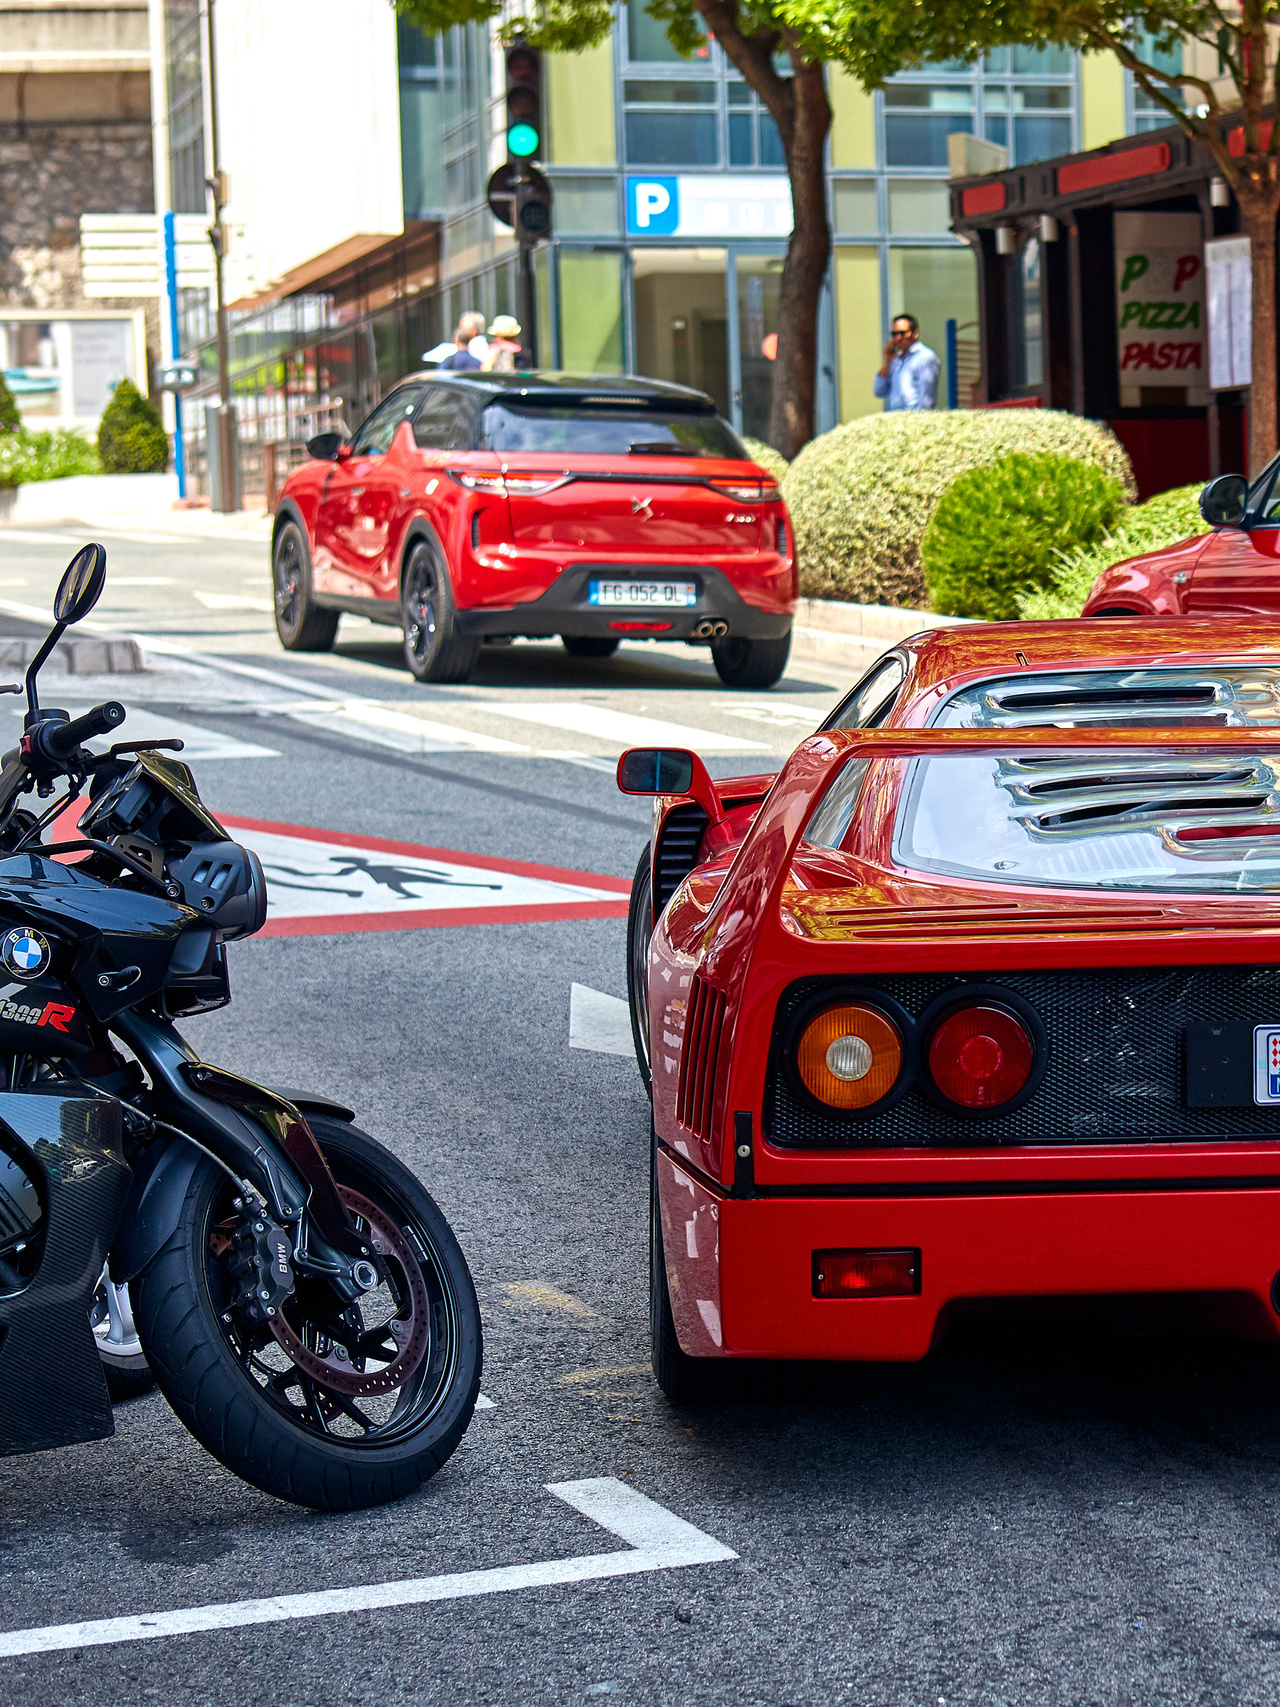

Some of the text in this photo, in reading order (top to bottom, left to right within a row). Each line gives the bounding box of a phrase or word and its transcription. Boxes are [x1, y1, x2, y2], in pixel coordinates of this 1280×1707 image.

[635, 182, 670, 227] P
[1120, 301, 1199, 329] PIZZA
[1121, 342, 1202, 370] PASTA
[9, 929, 48, 951] BMW
[0, 982, 76, 1033] 1300R
[277, 1242, 287, 1274] BMW
